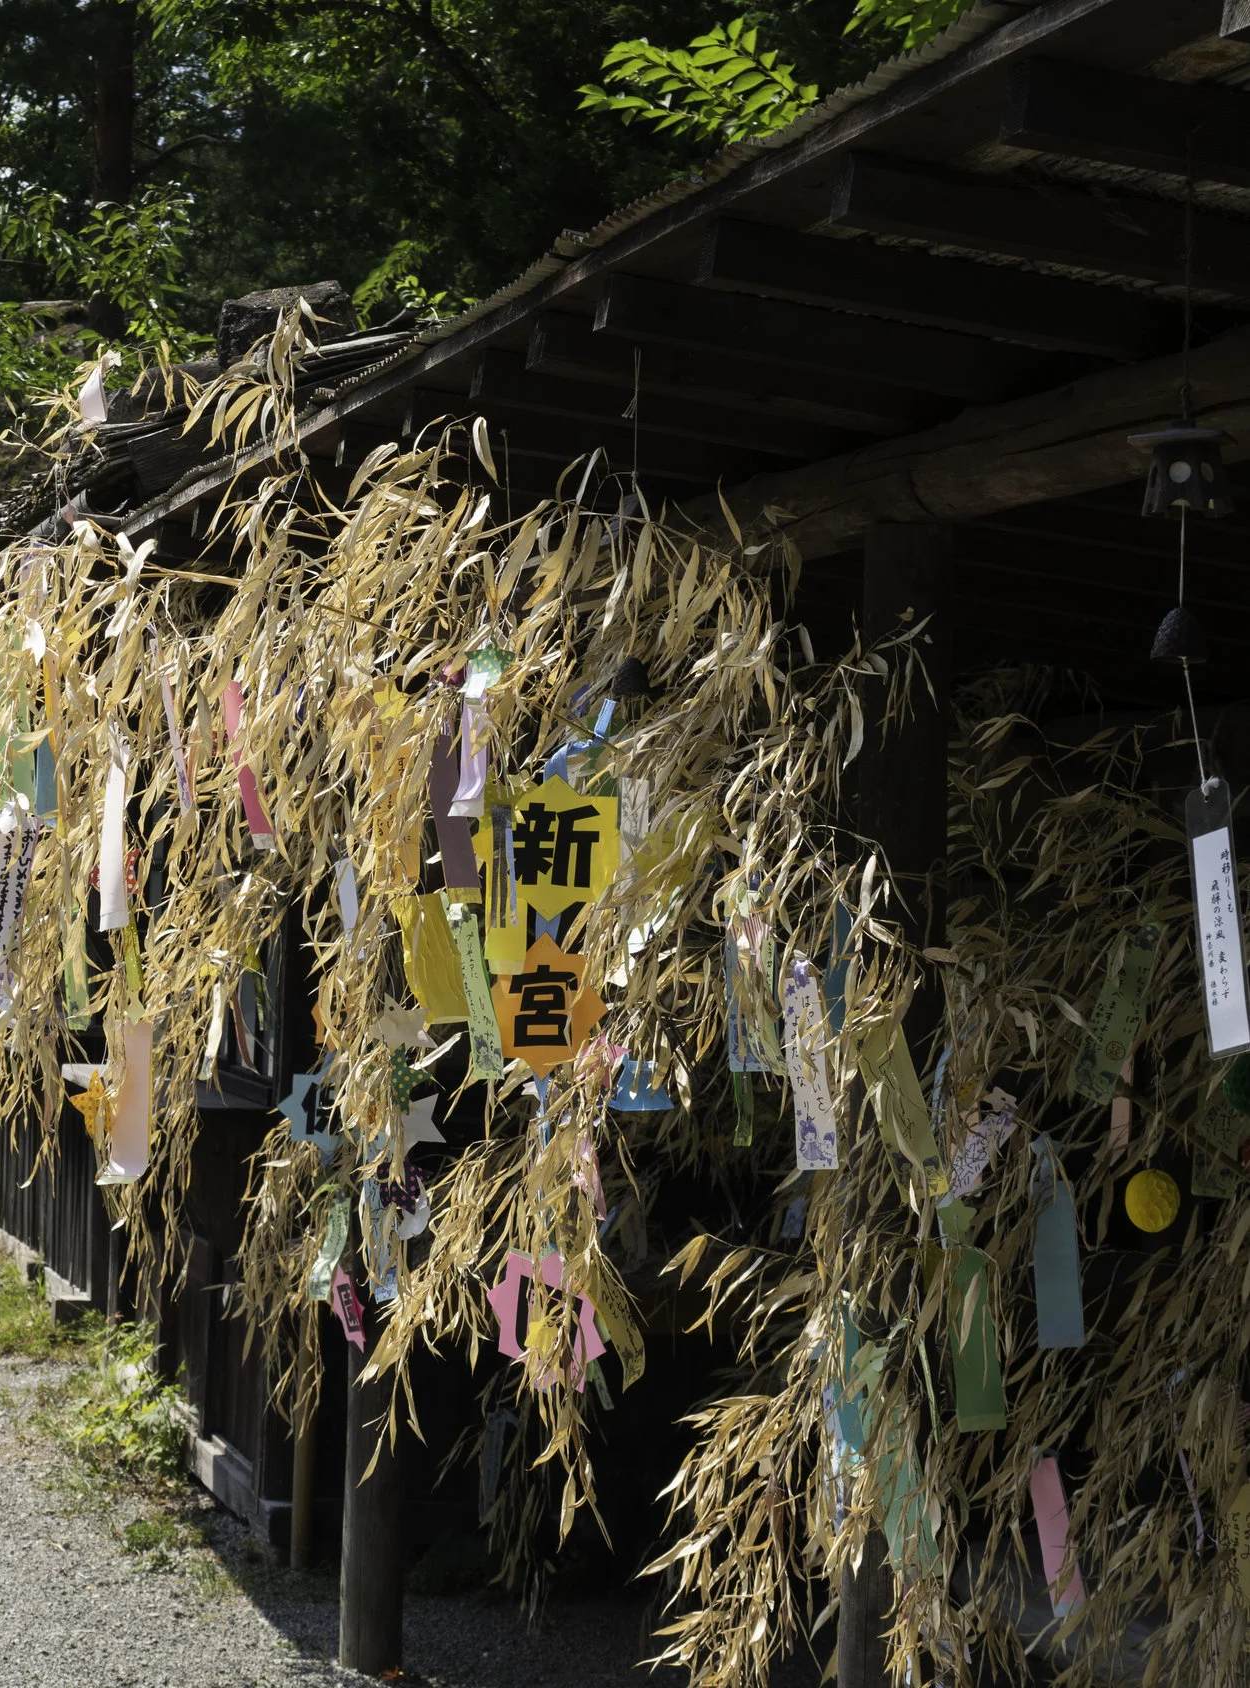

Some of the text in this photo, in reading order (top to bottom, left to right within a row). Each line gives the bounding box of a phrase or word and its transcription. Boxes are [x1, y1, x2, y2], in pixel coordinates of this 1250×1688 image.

[509, 802, 601, 889] 新
[1220, 848, 1235, 914] 時移りしも
[509, 965, 578, 1048] 宮
